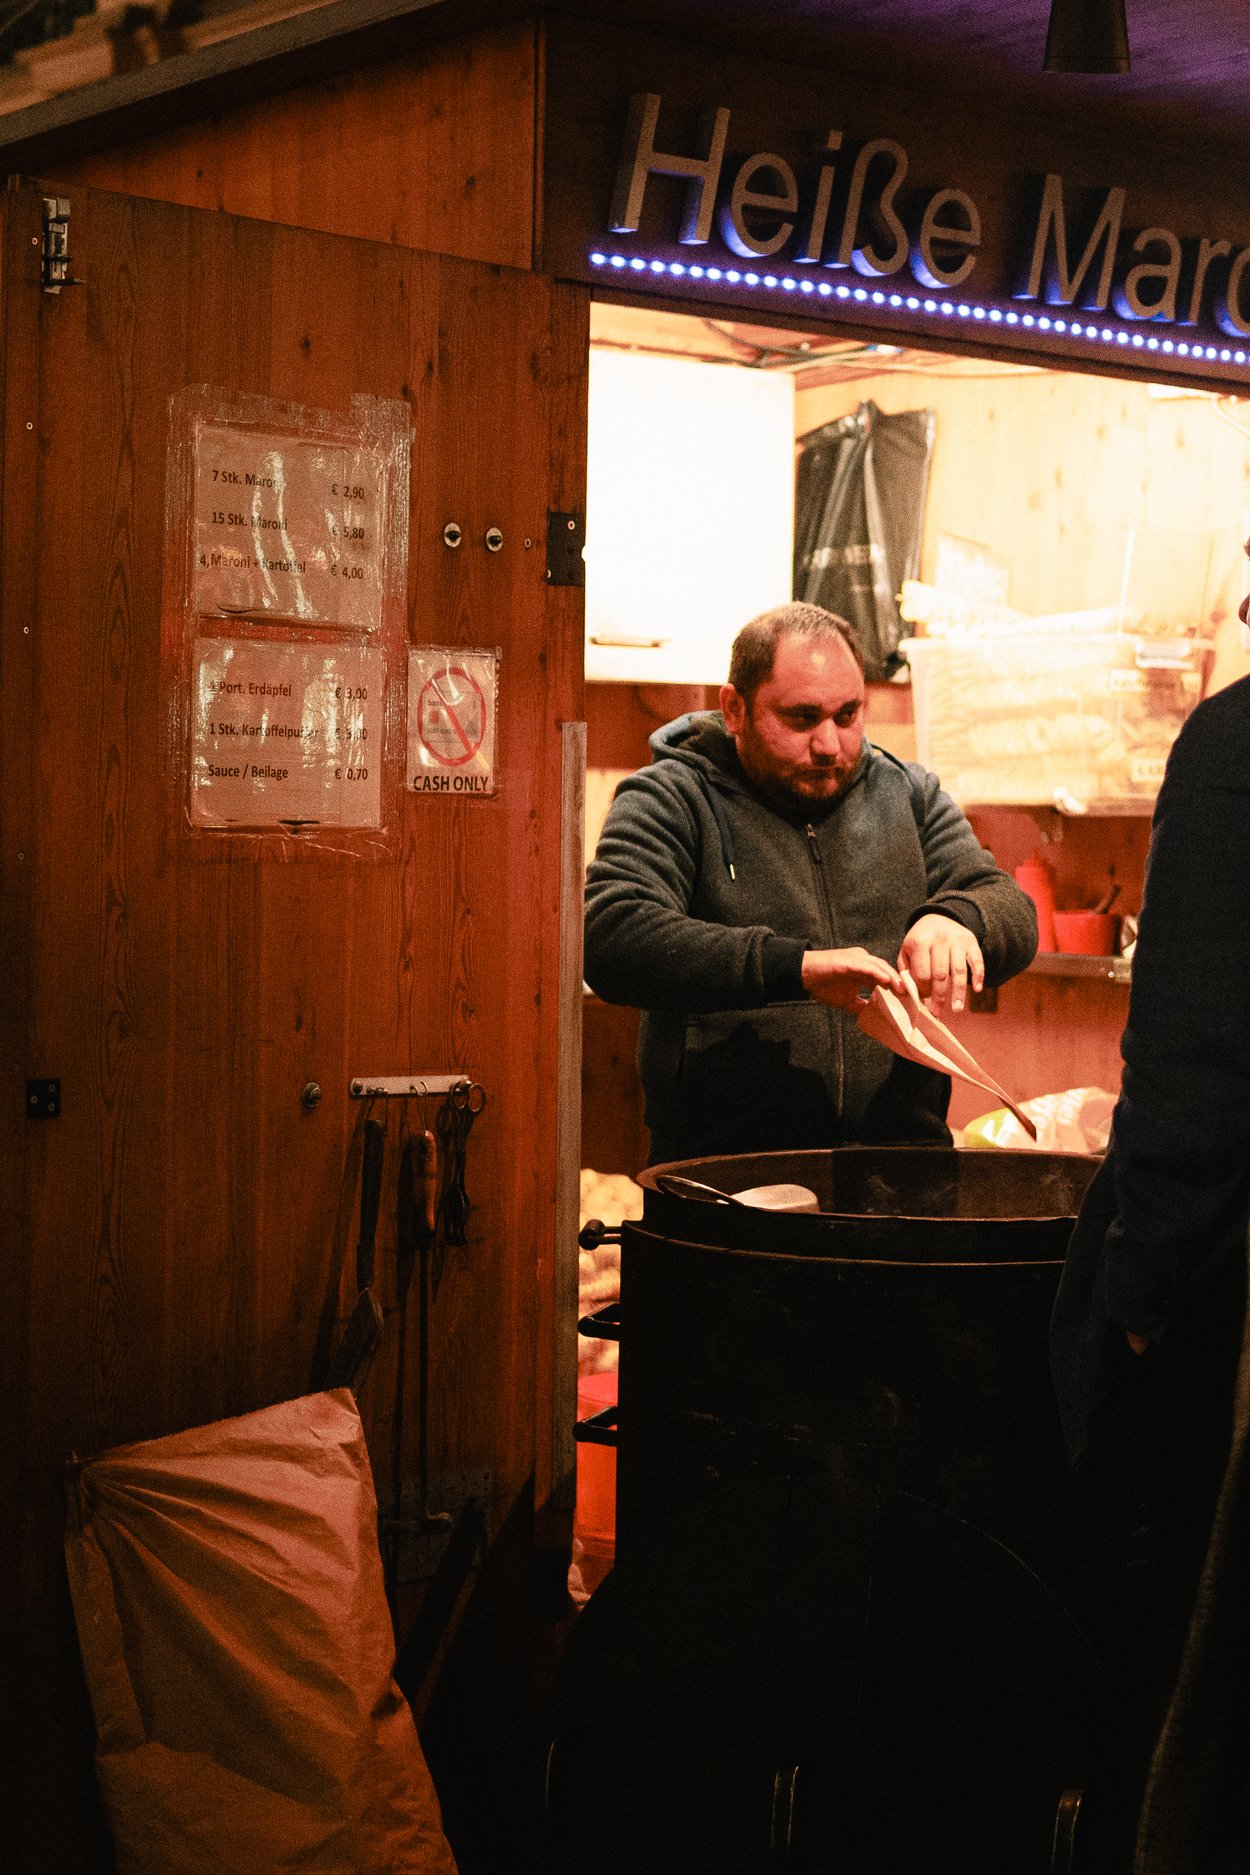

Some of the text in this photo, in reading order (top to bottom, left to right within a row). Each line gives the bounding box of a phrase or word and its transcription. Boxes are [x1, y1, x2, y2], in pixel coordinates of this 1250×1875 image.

[609, 93, 981, 289] Heiße
[212, 470, 285, 489] 7 Stk. Maro
[331, 483, 365, 500] € 2,90
[212, 512, 225, 524] 15
[228, 513, 248, 527] Stk.
[343, 526, 365, 540] 5,80
[342, 566, 364, 580] 4,00
[219, 681, 246, 696] Port.
[249, 682, 292, 699] Erdäpfel
[335, 686, 368, 701] € 3,00
[209, 723, 216, 736] 1
[218, 723, 239, 737] Stk.
[208, 764, 289, 781] Sauce / Beilage
[334, 768, 368, 781] € 0,70
[413, 775, 489, 792] CASH ONLY
